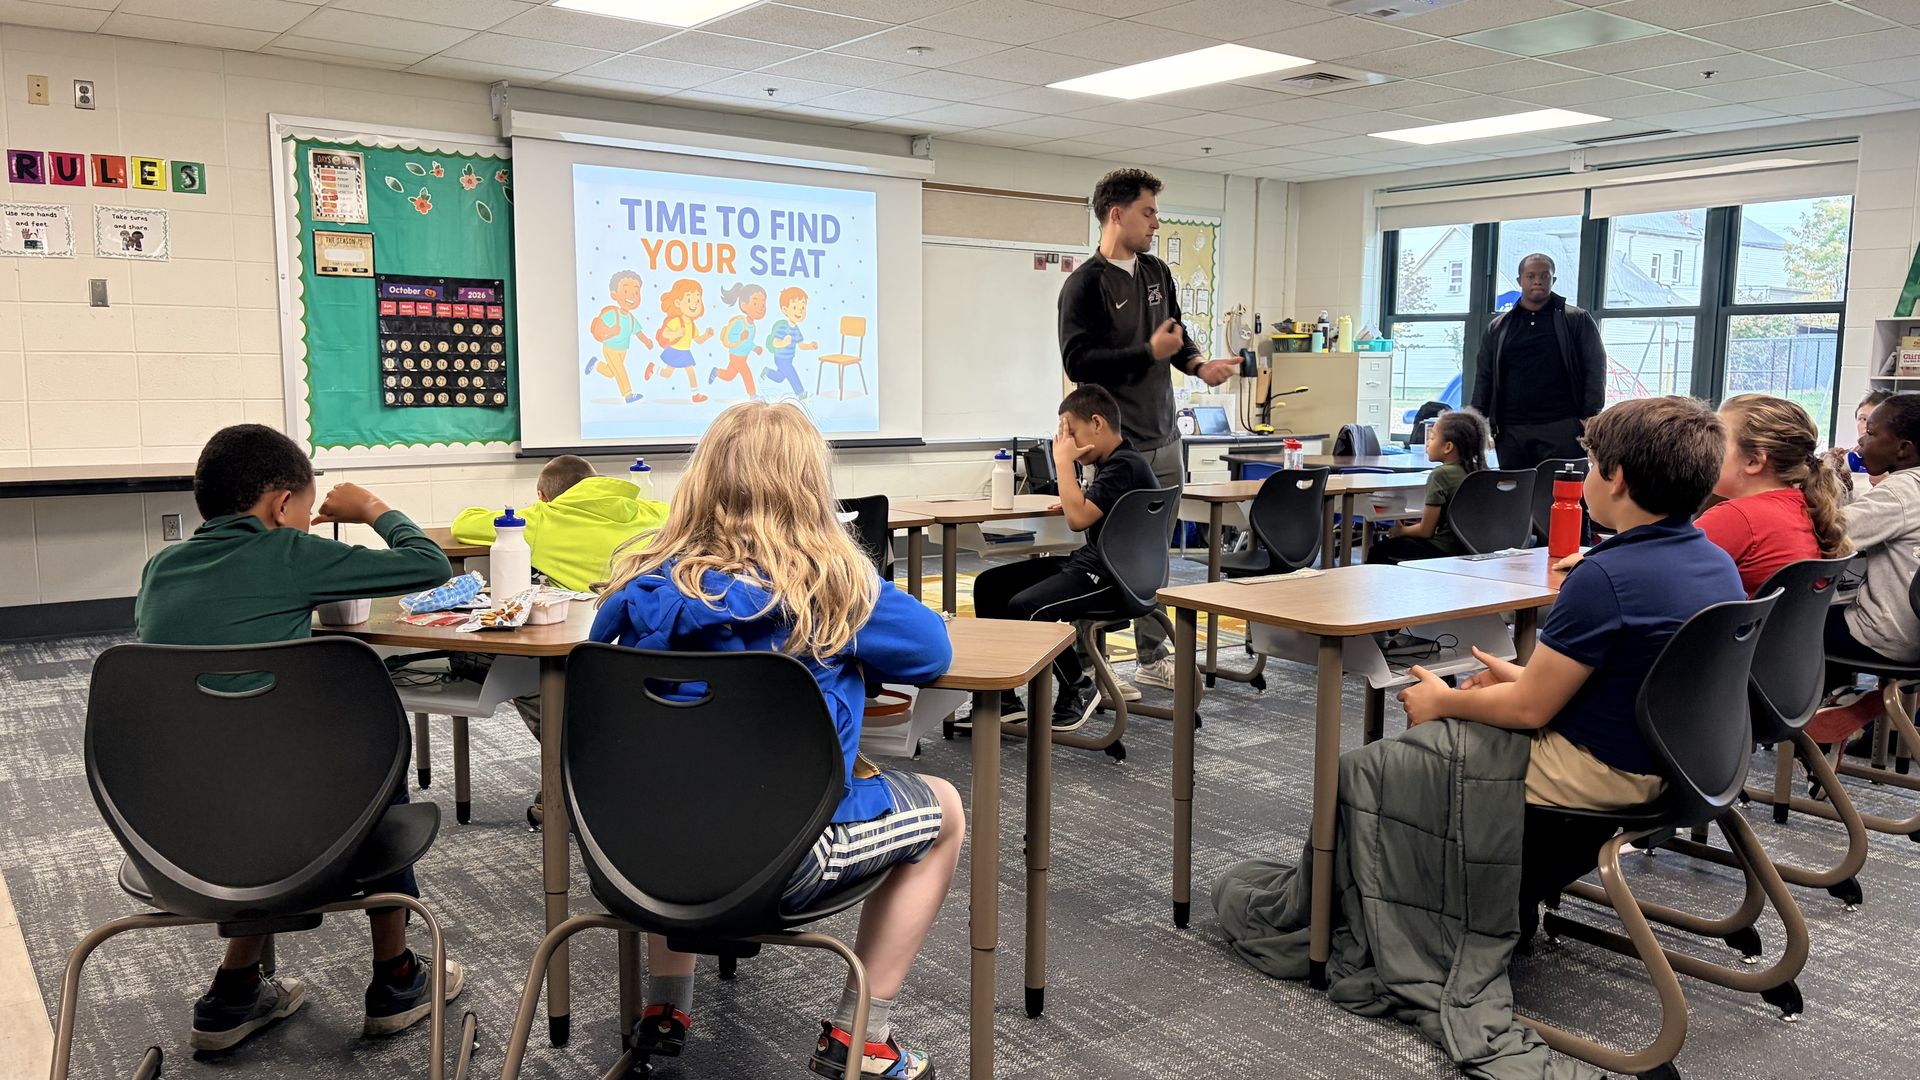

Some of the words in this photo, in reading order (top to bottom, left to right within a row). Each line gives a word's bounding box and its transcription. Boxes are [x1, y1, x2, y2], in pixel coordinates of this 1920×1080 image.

[16, 153, 199, 189] RULES
[619, 197, 707, 236] TIME
[716, 205, 760, 239] TO
[770, 210, 841, 244] FIND
[640, 237, 737, 275] YOUR
[749, 244, 826, 279] SEAT
[388, 286, 420, 295] October
